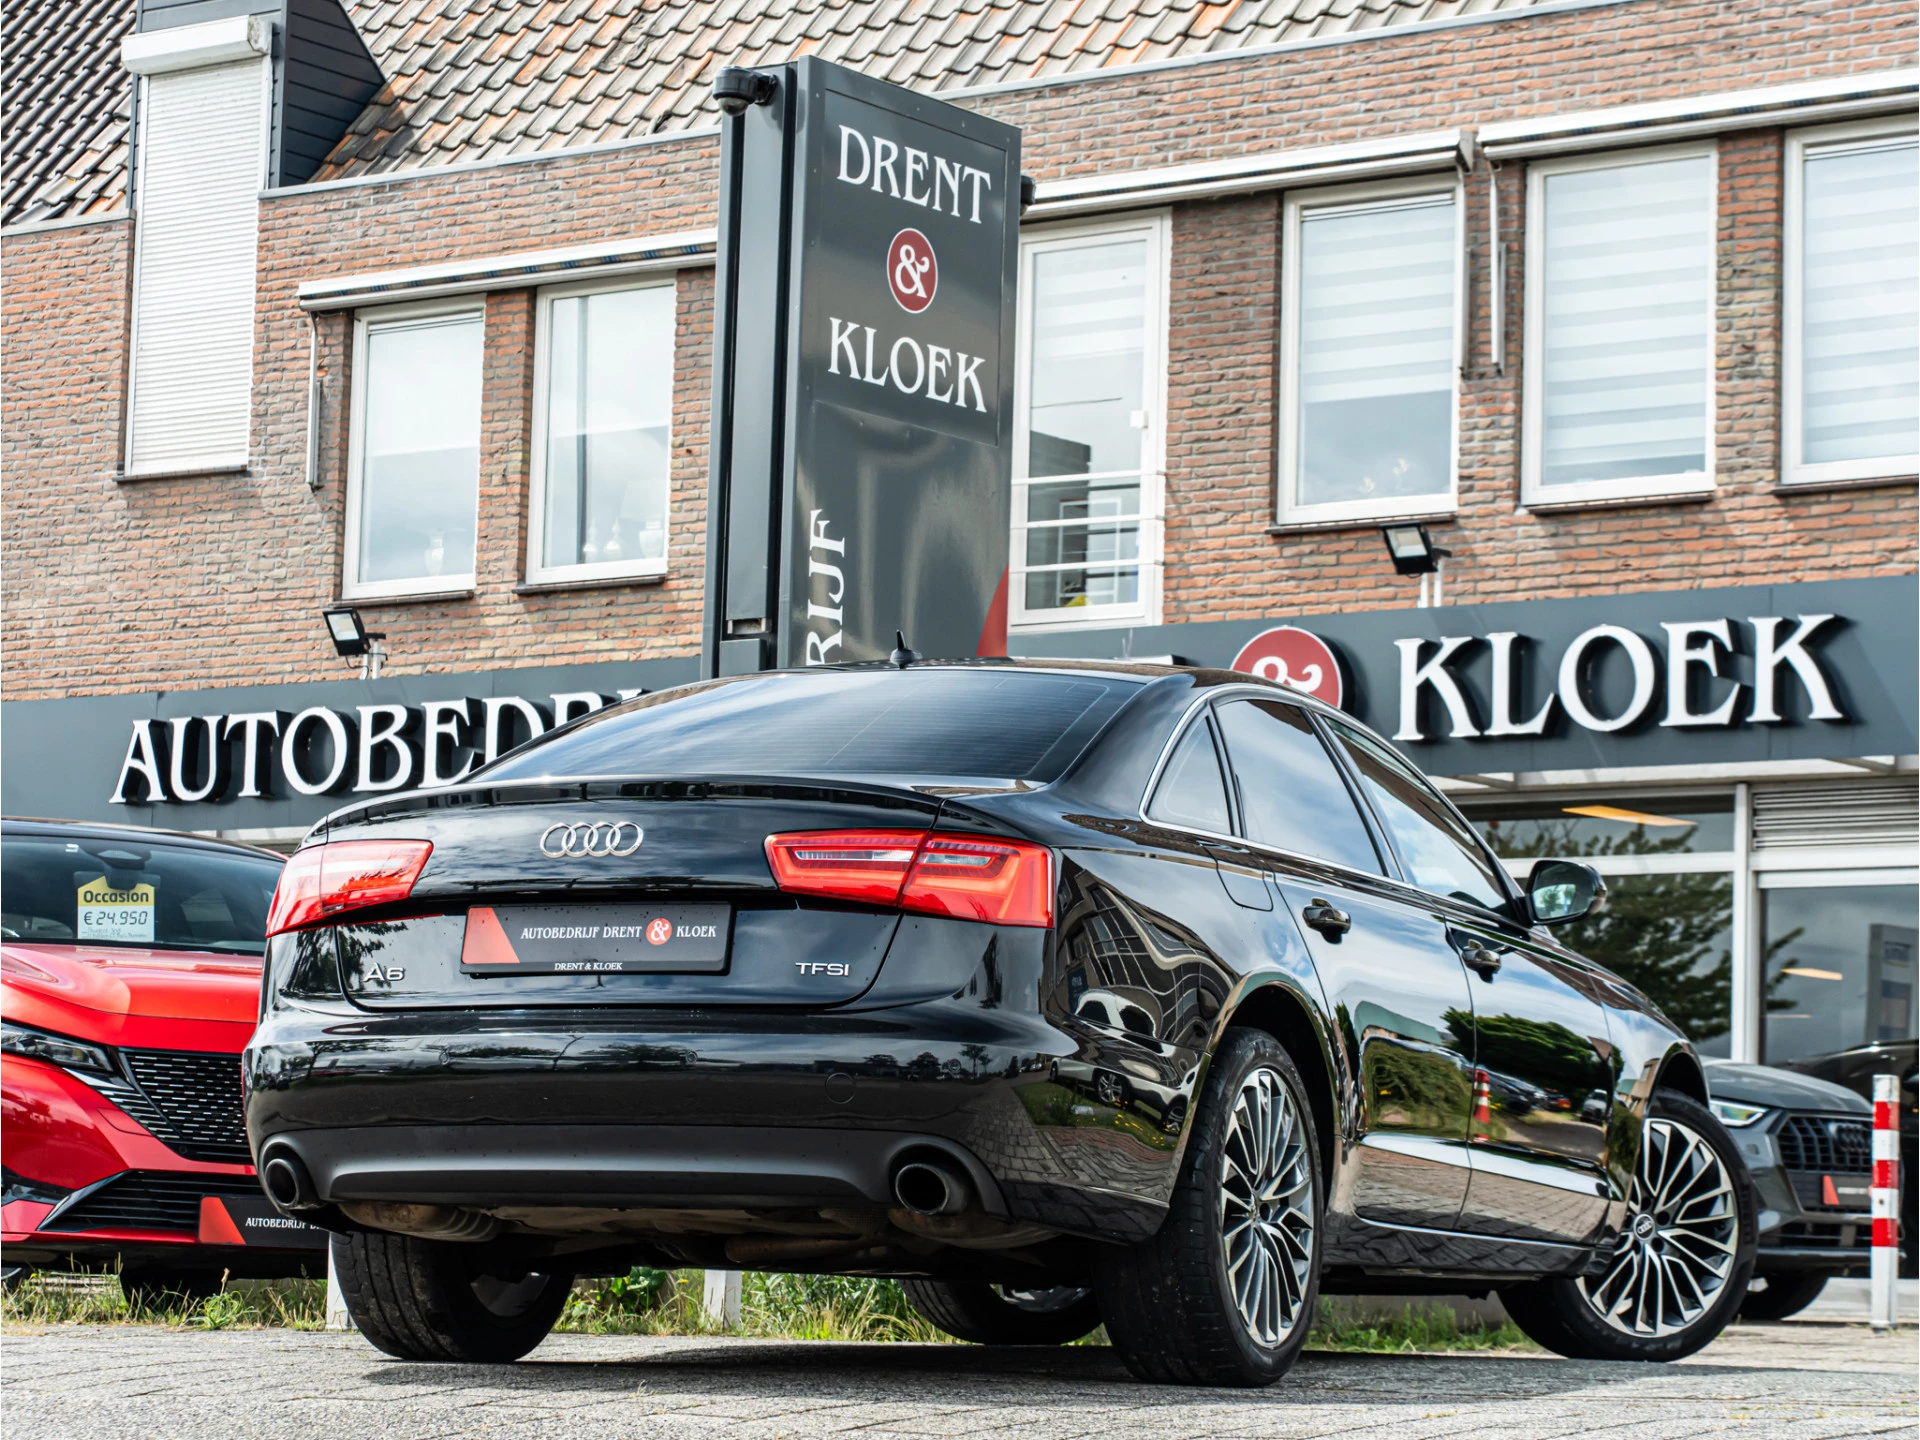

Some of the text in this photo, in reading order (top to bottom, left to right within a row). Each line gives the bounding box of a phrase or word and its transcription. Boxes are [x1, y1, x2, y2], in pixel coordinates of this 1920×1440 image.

[837, 125, 991, 224] DRENT
[895, 244, 930, 298] &
[828, 317, 988, 412] KLOEK
[1393, 613, 1844, 742] KLOEK
[83, 890, 149, 903] Occasion
[521, 920, 717, 941] AUTOBEDRIJF DRENT & KLOEK
[363, 962, 405, 982] A6
[554, 962, 623, 971] DRENT & KLOEK
[795, 962, 850, 976] TFSI
